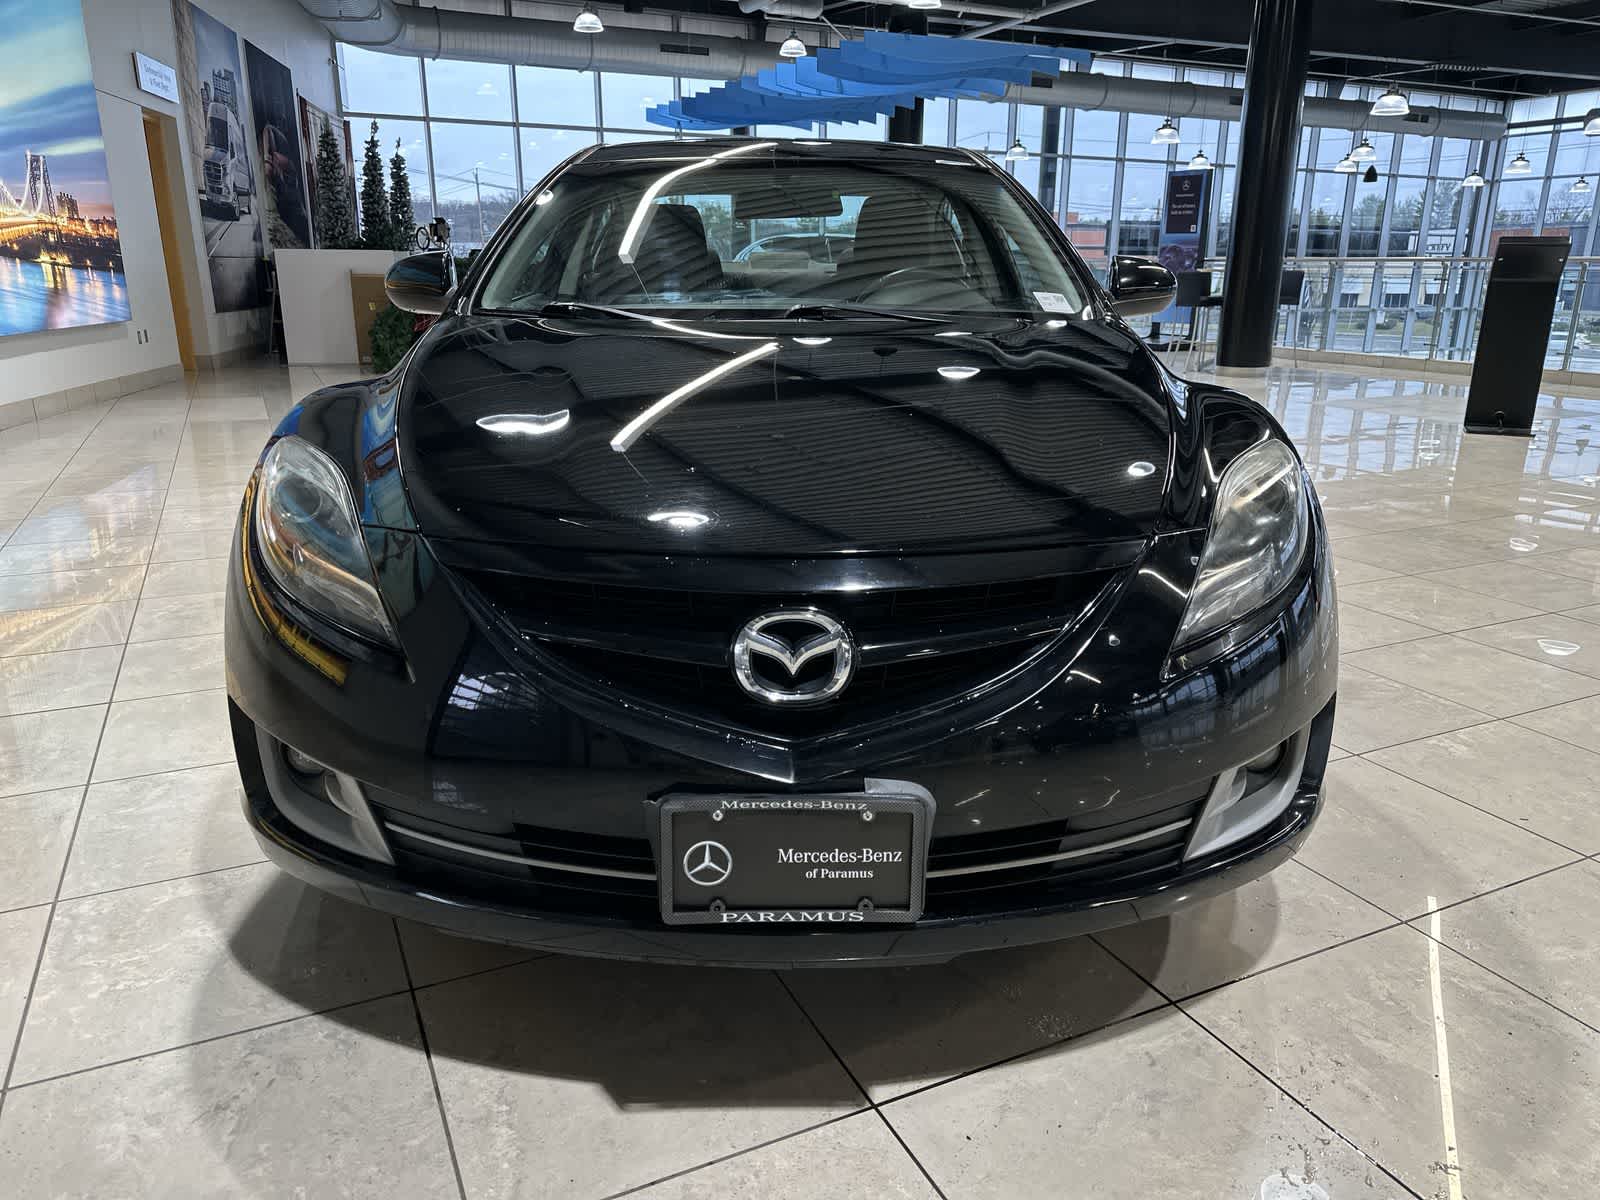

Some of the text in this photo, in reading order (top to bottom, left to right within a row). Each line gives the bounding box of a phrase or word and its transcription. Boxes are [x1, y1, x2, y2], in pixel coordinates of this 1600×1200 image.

[719, 800, 868, 811] Mercedes-Benz
[777, 848, 902, 864] Mercedes-Benz
[805, 868, 874, 880] of Paramus
[719, 911, 865, 923] PARAMUS
